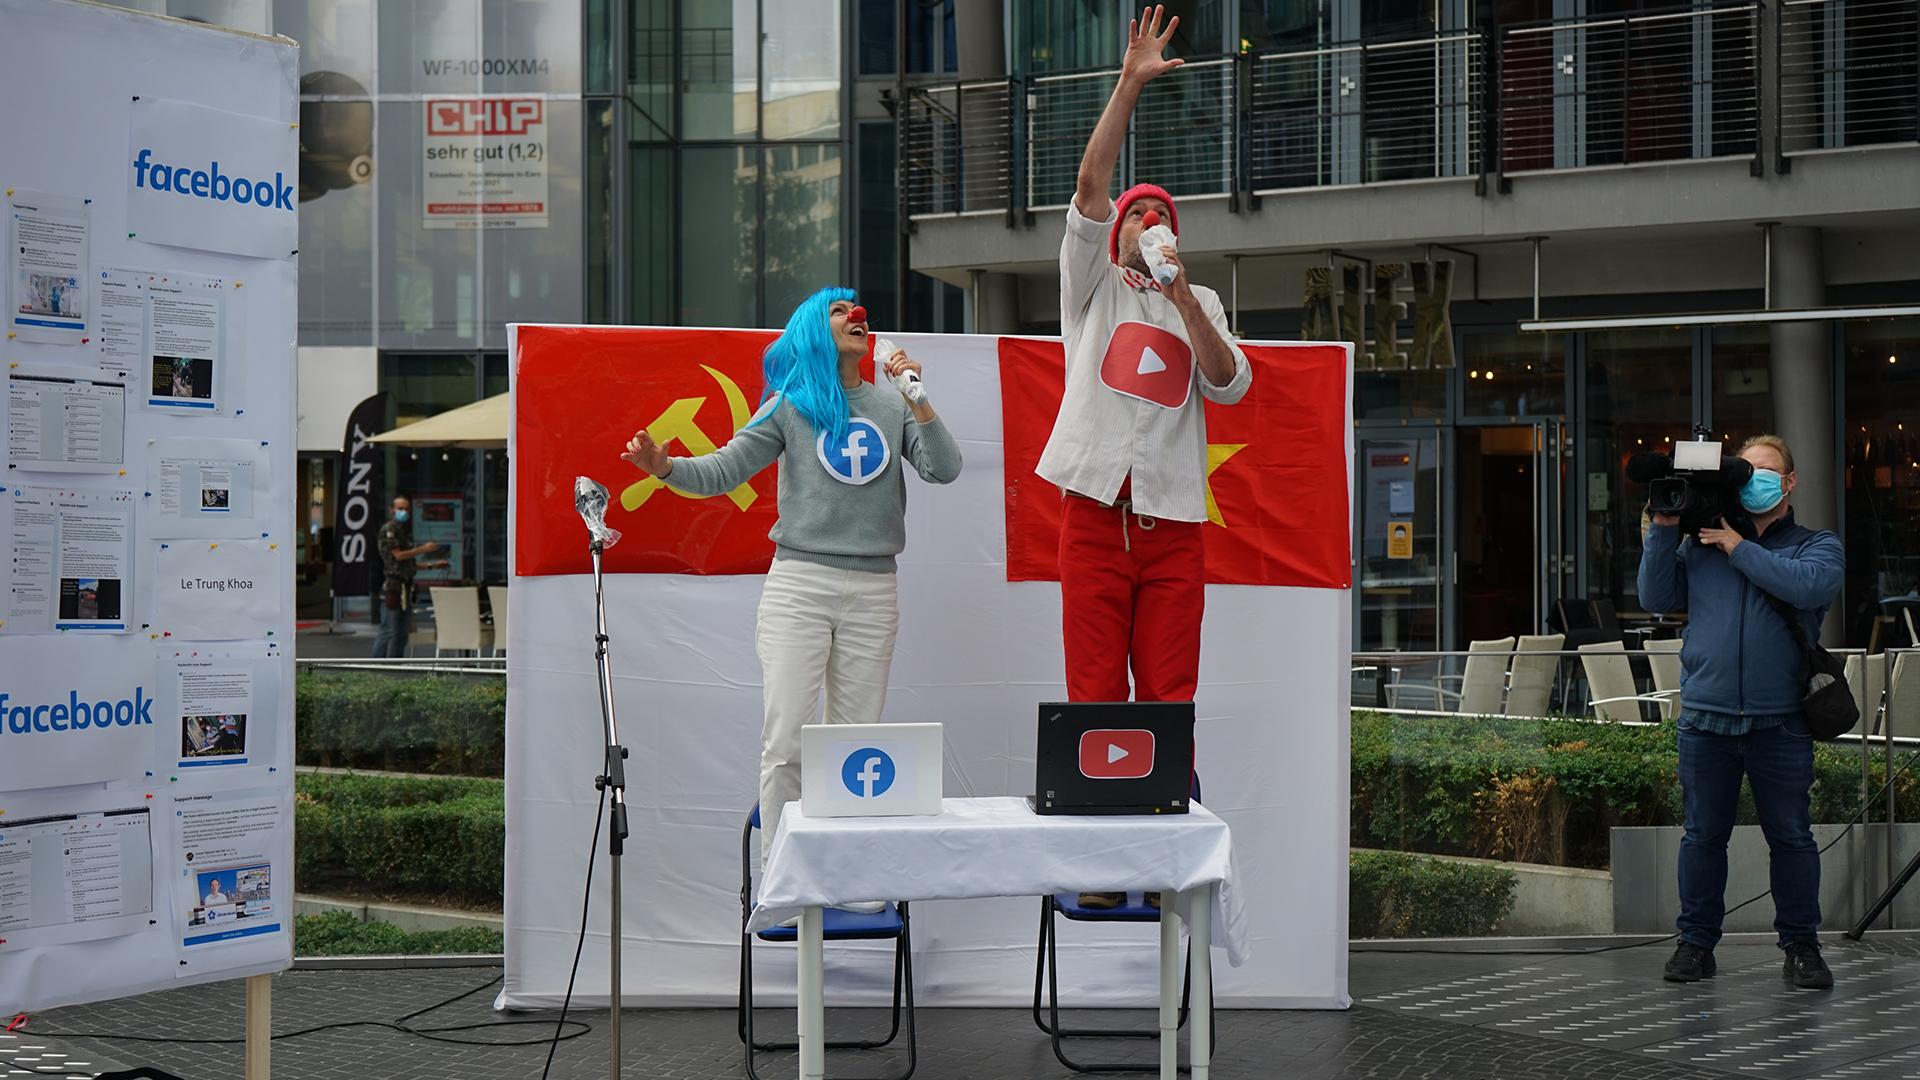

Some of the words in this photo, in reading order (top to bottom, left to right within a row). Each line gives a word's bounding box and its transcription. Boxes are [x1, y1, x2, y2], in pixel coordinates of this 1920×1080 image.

[422, 59, 549, 76] WF-1000XM4
[429, 101, 540, 134] CHIP
[426, 144, 468, 160] sehr
[474, 147, 504, 163] gut
[508, 143, 544, 163] (1,2)
[133, 148, 294, 211] facebook
[1300, 259, 1456, 371] ALEX
[341, 424, 375, 564] SONY
[181, 578, 193, 589] Le
[195, 578, 225, 592] Trung
[227, 578, 253, 589] Khoa
[0, 686, 154, 735] facebook
